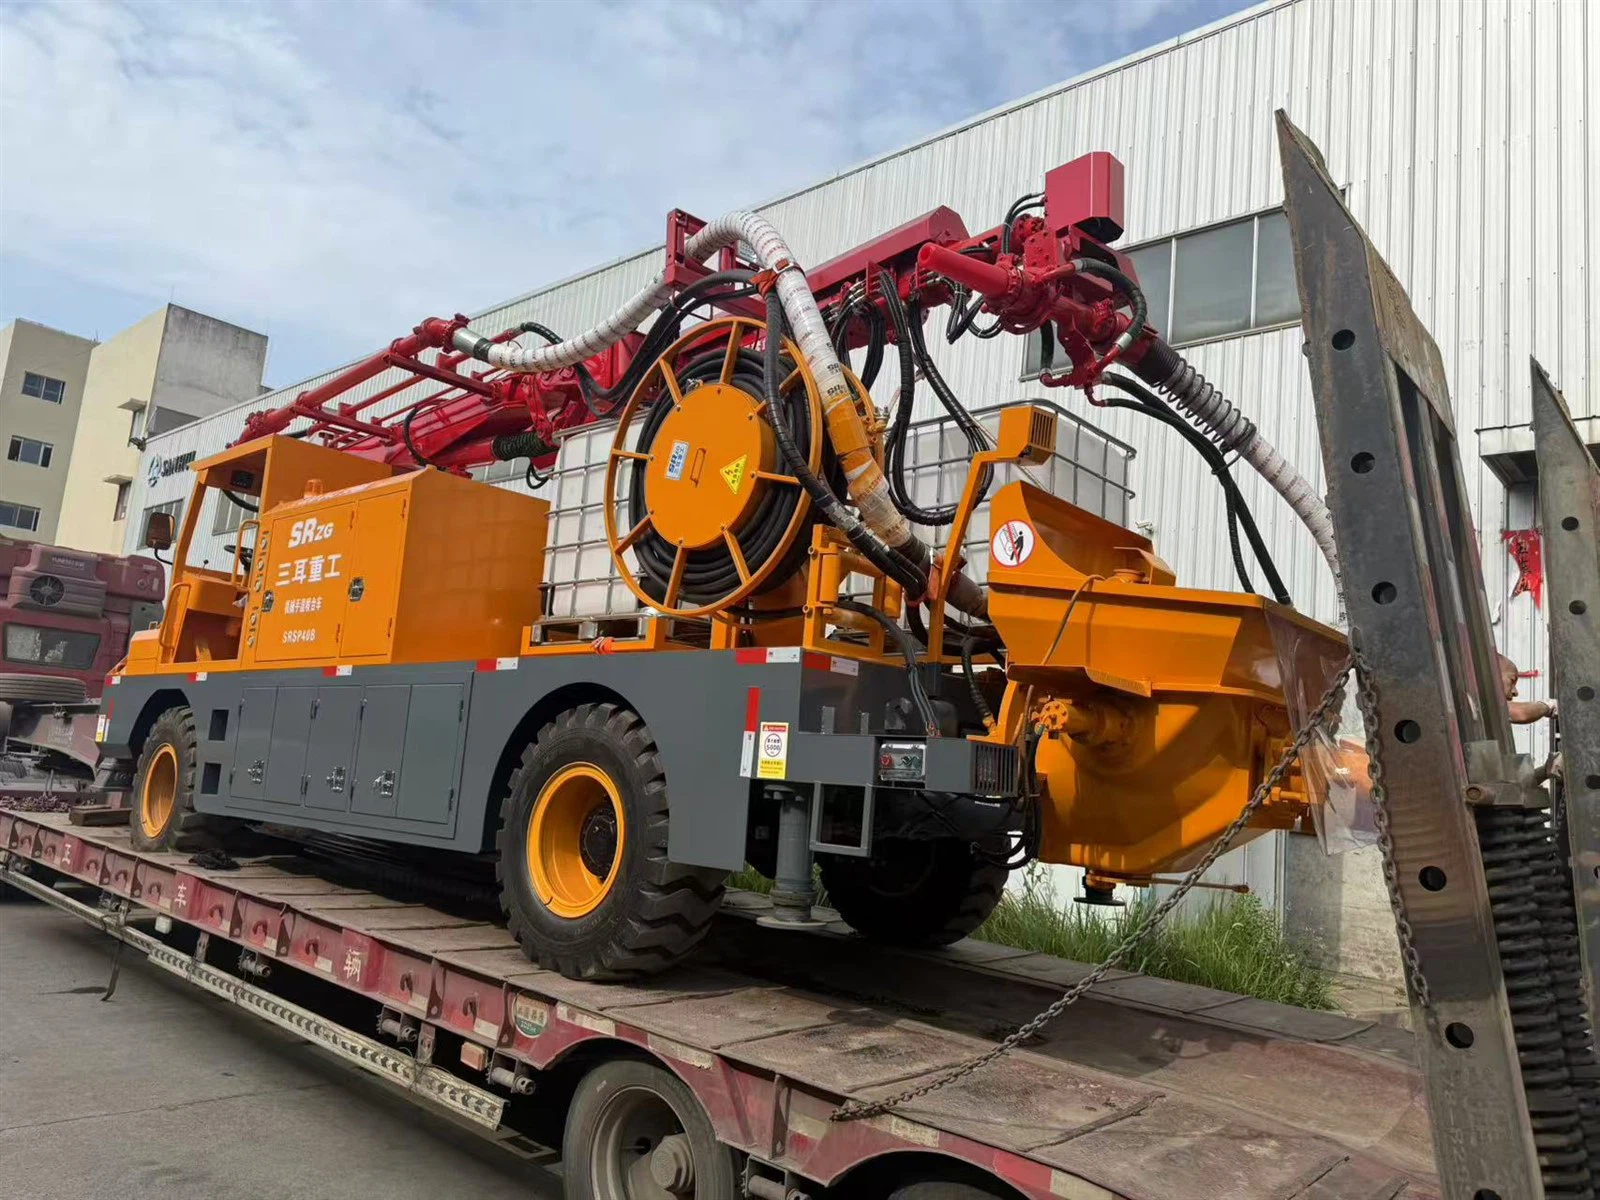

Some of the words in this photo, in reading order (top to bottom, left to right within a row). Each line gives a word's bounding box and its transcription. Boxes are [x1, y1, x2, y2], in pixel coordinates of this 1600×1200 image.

[275, 553, 342, 587] 三耳重工
[174, 881, 187, 909] 车
